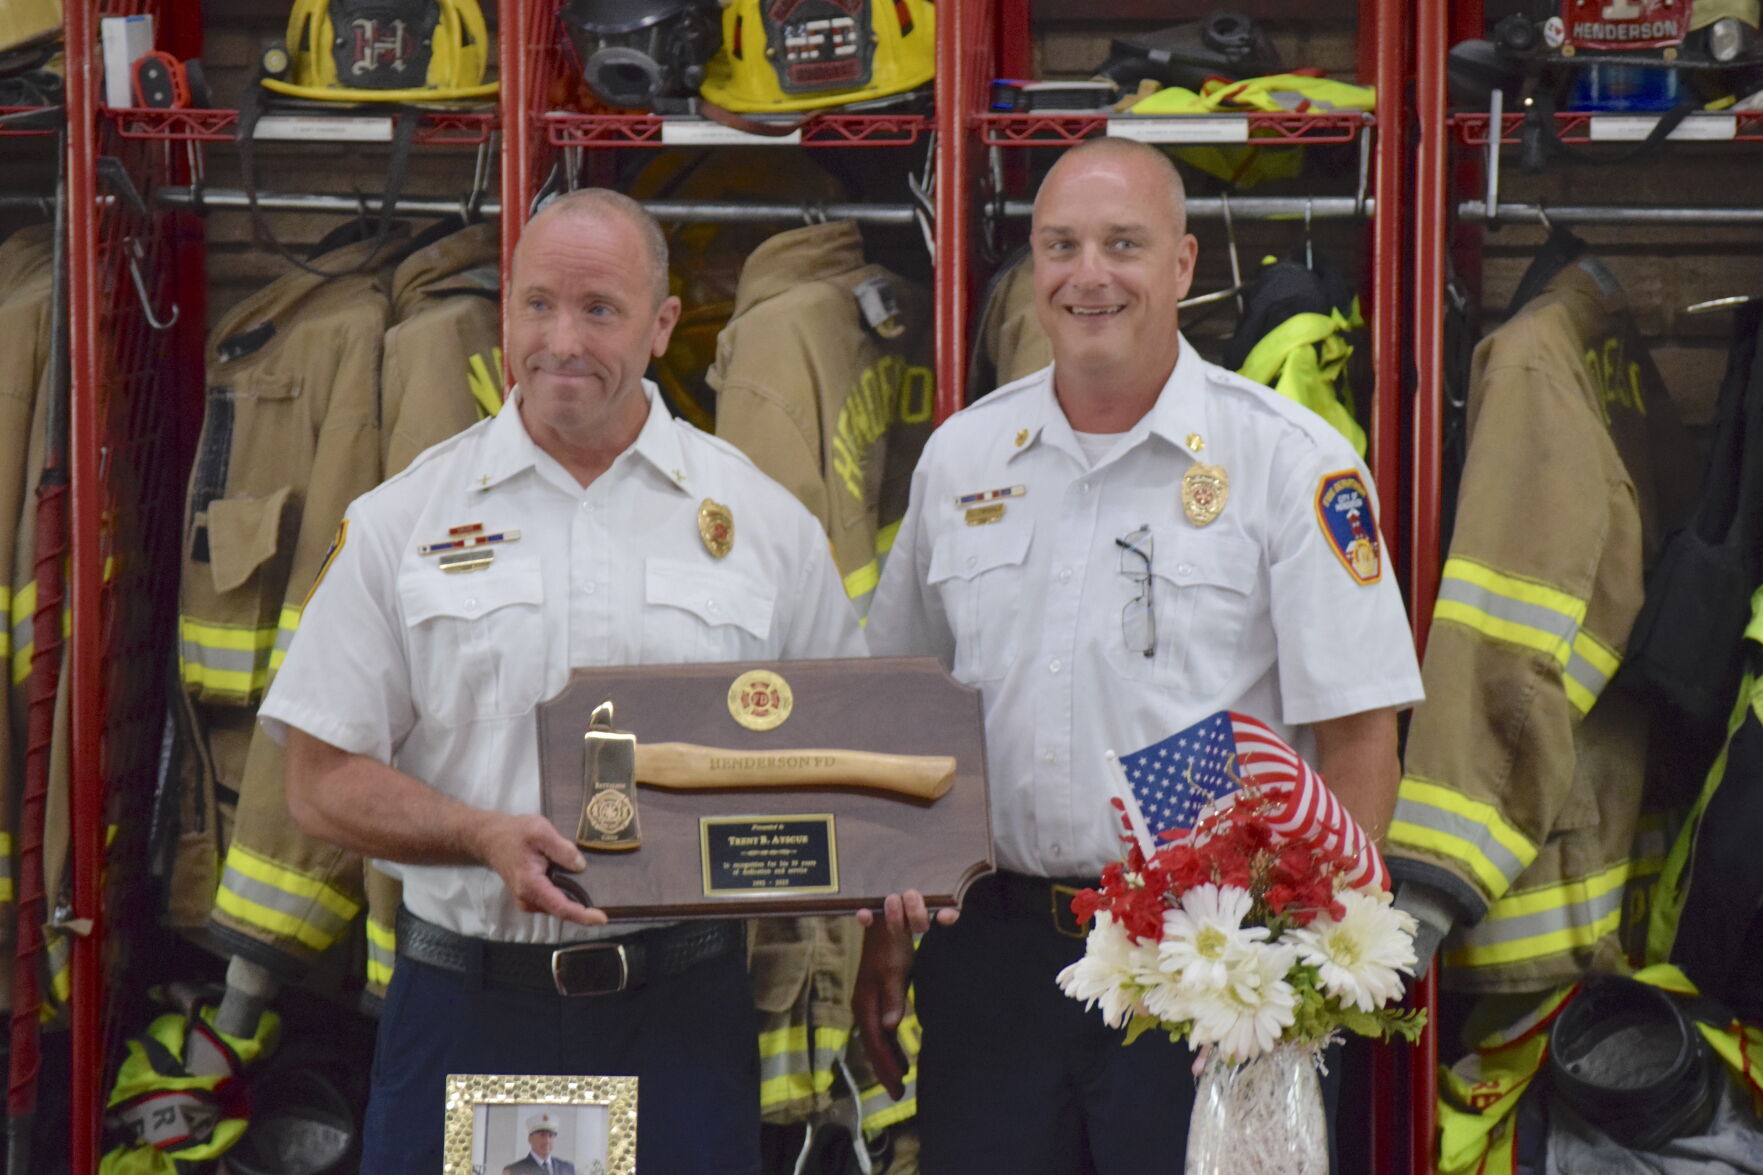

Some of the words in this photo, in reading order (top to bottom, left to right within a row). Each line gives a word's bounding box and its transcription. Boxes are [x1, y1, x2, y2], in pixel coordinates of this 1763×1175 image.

[1573, 20, 1678, 40] HENDERSON
[709, 756, 811, 770] HENDERSON
[814, 755, 837, 768] FD
